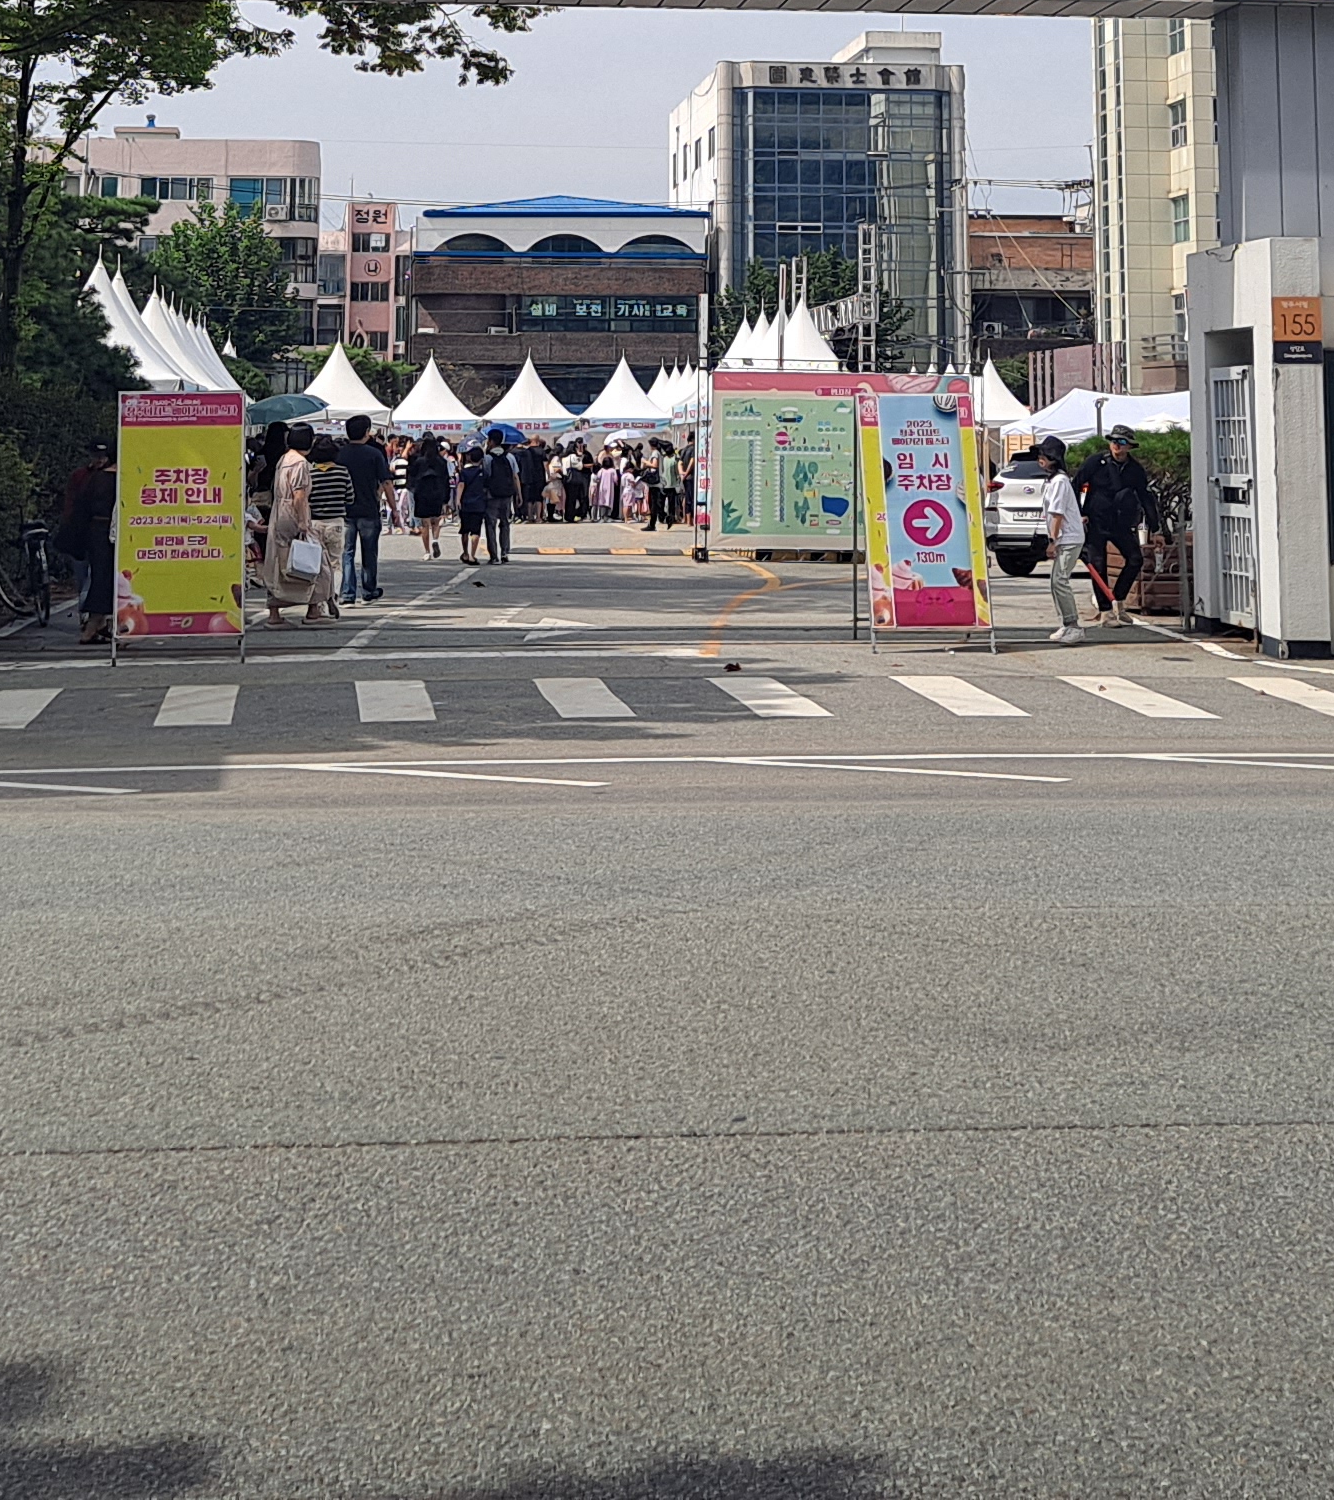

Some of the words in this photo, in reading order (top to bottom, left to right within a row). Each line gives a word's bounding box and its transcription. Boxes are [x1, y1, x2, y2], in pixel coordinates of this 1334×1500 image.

[354, 208, 388, 224] 정원
[530, 303, 557, 317] 설비
[575, 304, 603, 317] 보전
[1280, 313, 1316, 336] 155
[154, 468, 209, 485] 주차장
[896, 473, 953, 491] 주차장
[140, 487, 179, 505] 통제
[184, 487, 222, 504] 안내
[916, 551, 946, 563] 130m
